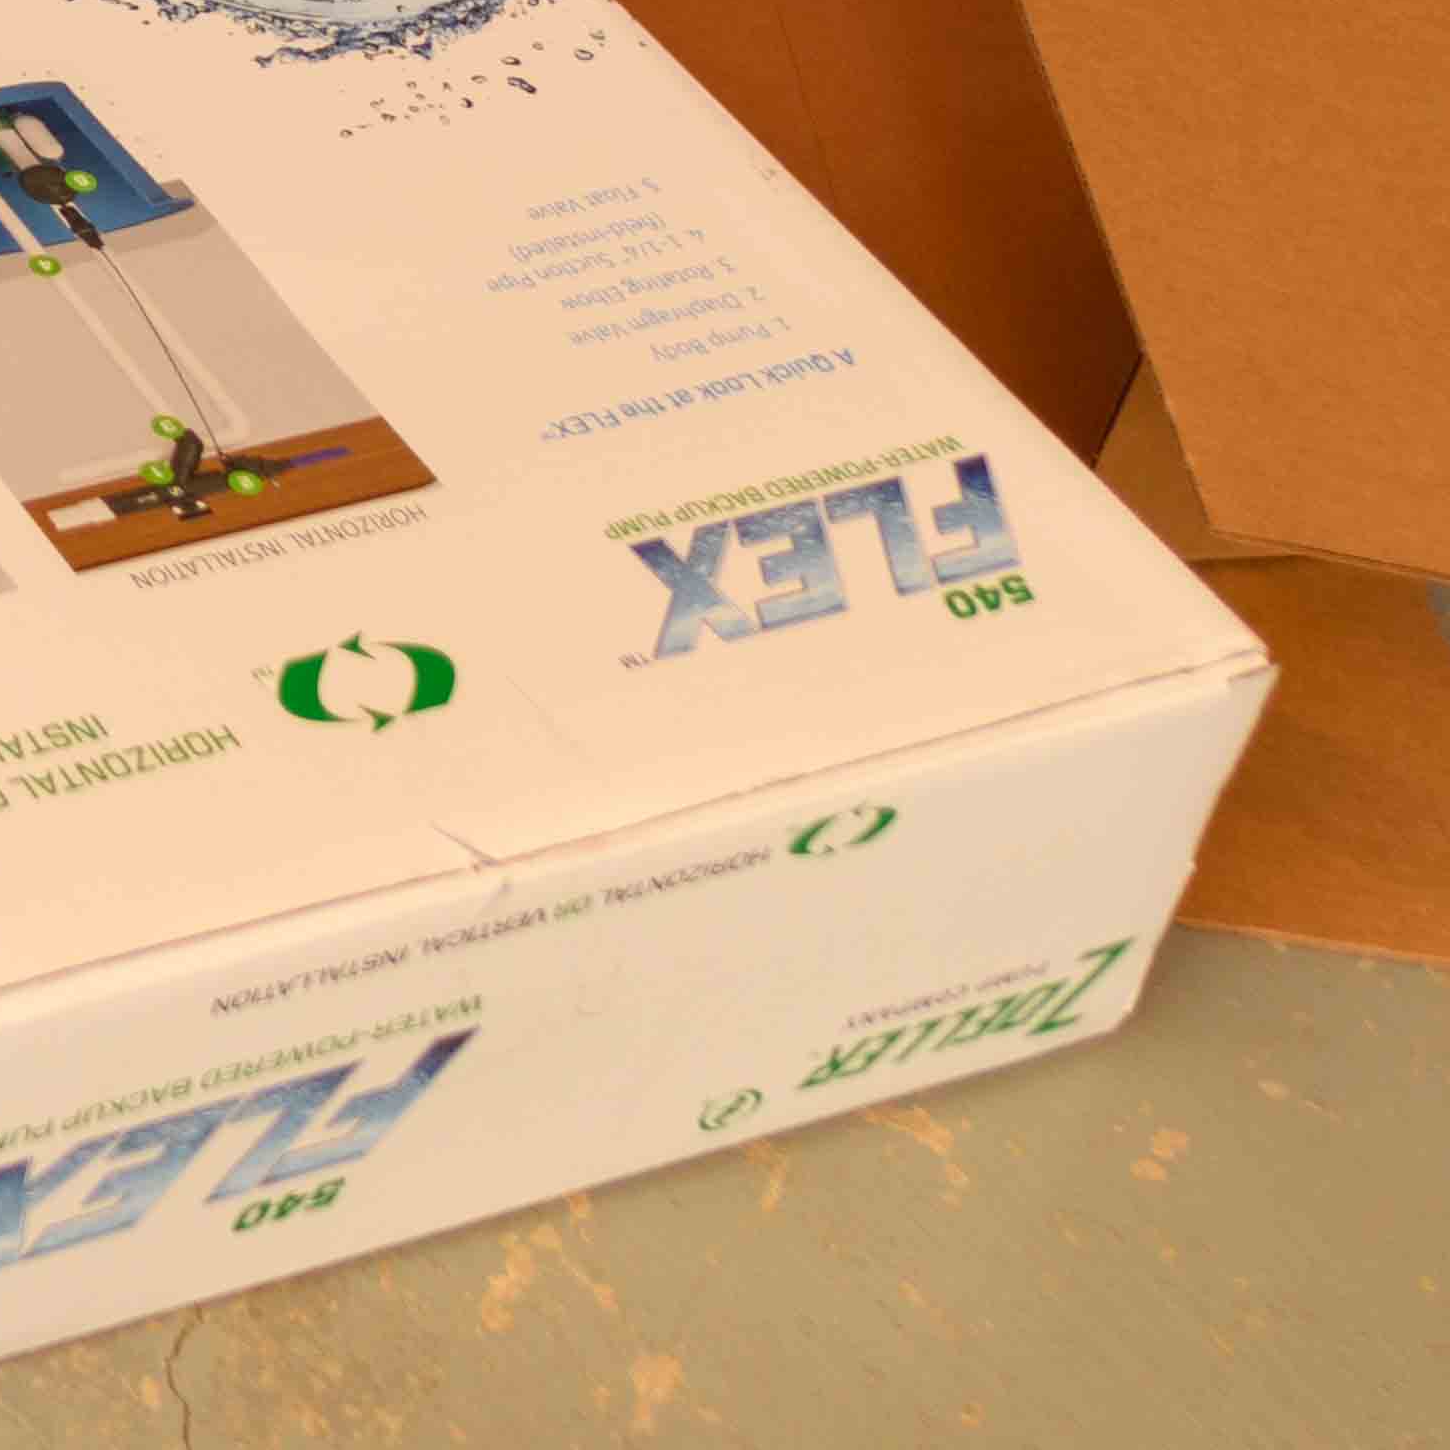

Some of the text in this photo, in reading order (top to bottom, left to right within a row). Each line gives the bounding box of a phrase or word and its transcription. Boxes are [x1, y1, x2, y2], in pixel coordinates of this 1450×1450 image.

[526, 198, 585, 221] Valve
[584, 183, 641, 208] Float
[532, 250, 615, 283] Suction
[620, 263, 715, 296] Rotating
[558, 285, 625, 311] Elbow
[569, 323, 627, 347] Valve
[648, 337, 711, 365] Body
[706, 322, 771, 349] Pump
[763, 352, 835, 385] Quick
[833, 346, 857, 367] A
[666, 387, 692, 413] at
[695, 371, 760, 403] Look
[618, 394, 665, 422] the
[602, 433, 963, 541] WATER-POWERED BACKUP PUMP
[127, 501, 428, 592] HORIZONTAL INSTALLATION
[626, 453, 1021, 661] FLEX
[941, 574, 1035, 620] 540
[9, 723, 241, 801] HORIZONTAL
[209, 847, 772, 1017] HORIZONTAL OR VERTICAL INSTALLATION
[794, 936, 1135, 1090] ZOELLER
[199, 993, 484, 1092] WATER-POWERED
[60, 1076, 195, 1140] BACKUP
[228, 1177, 347, 1234] 540
